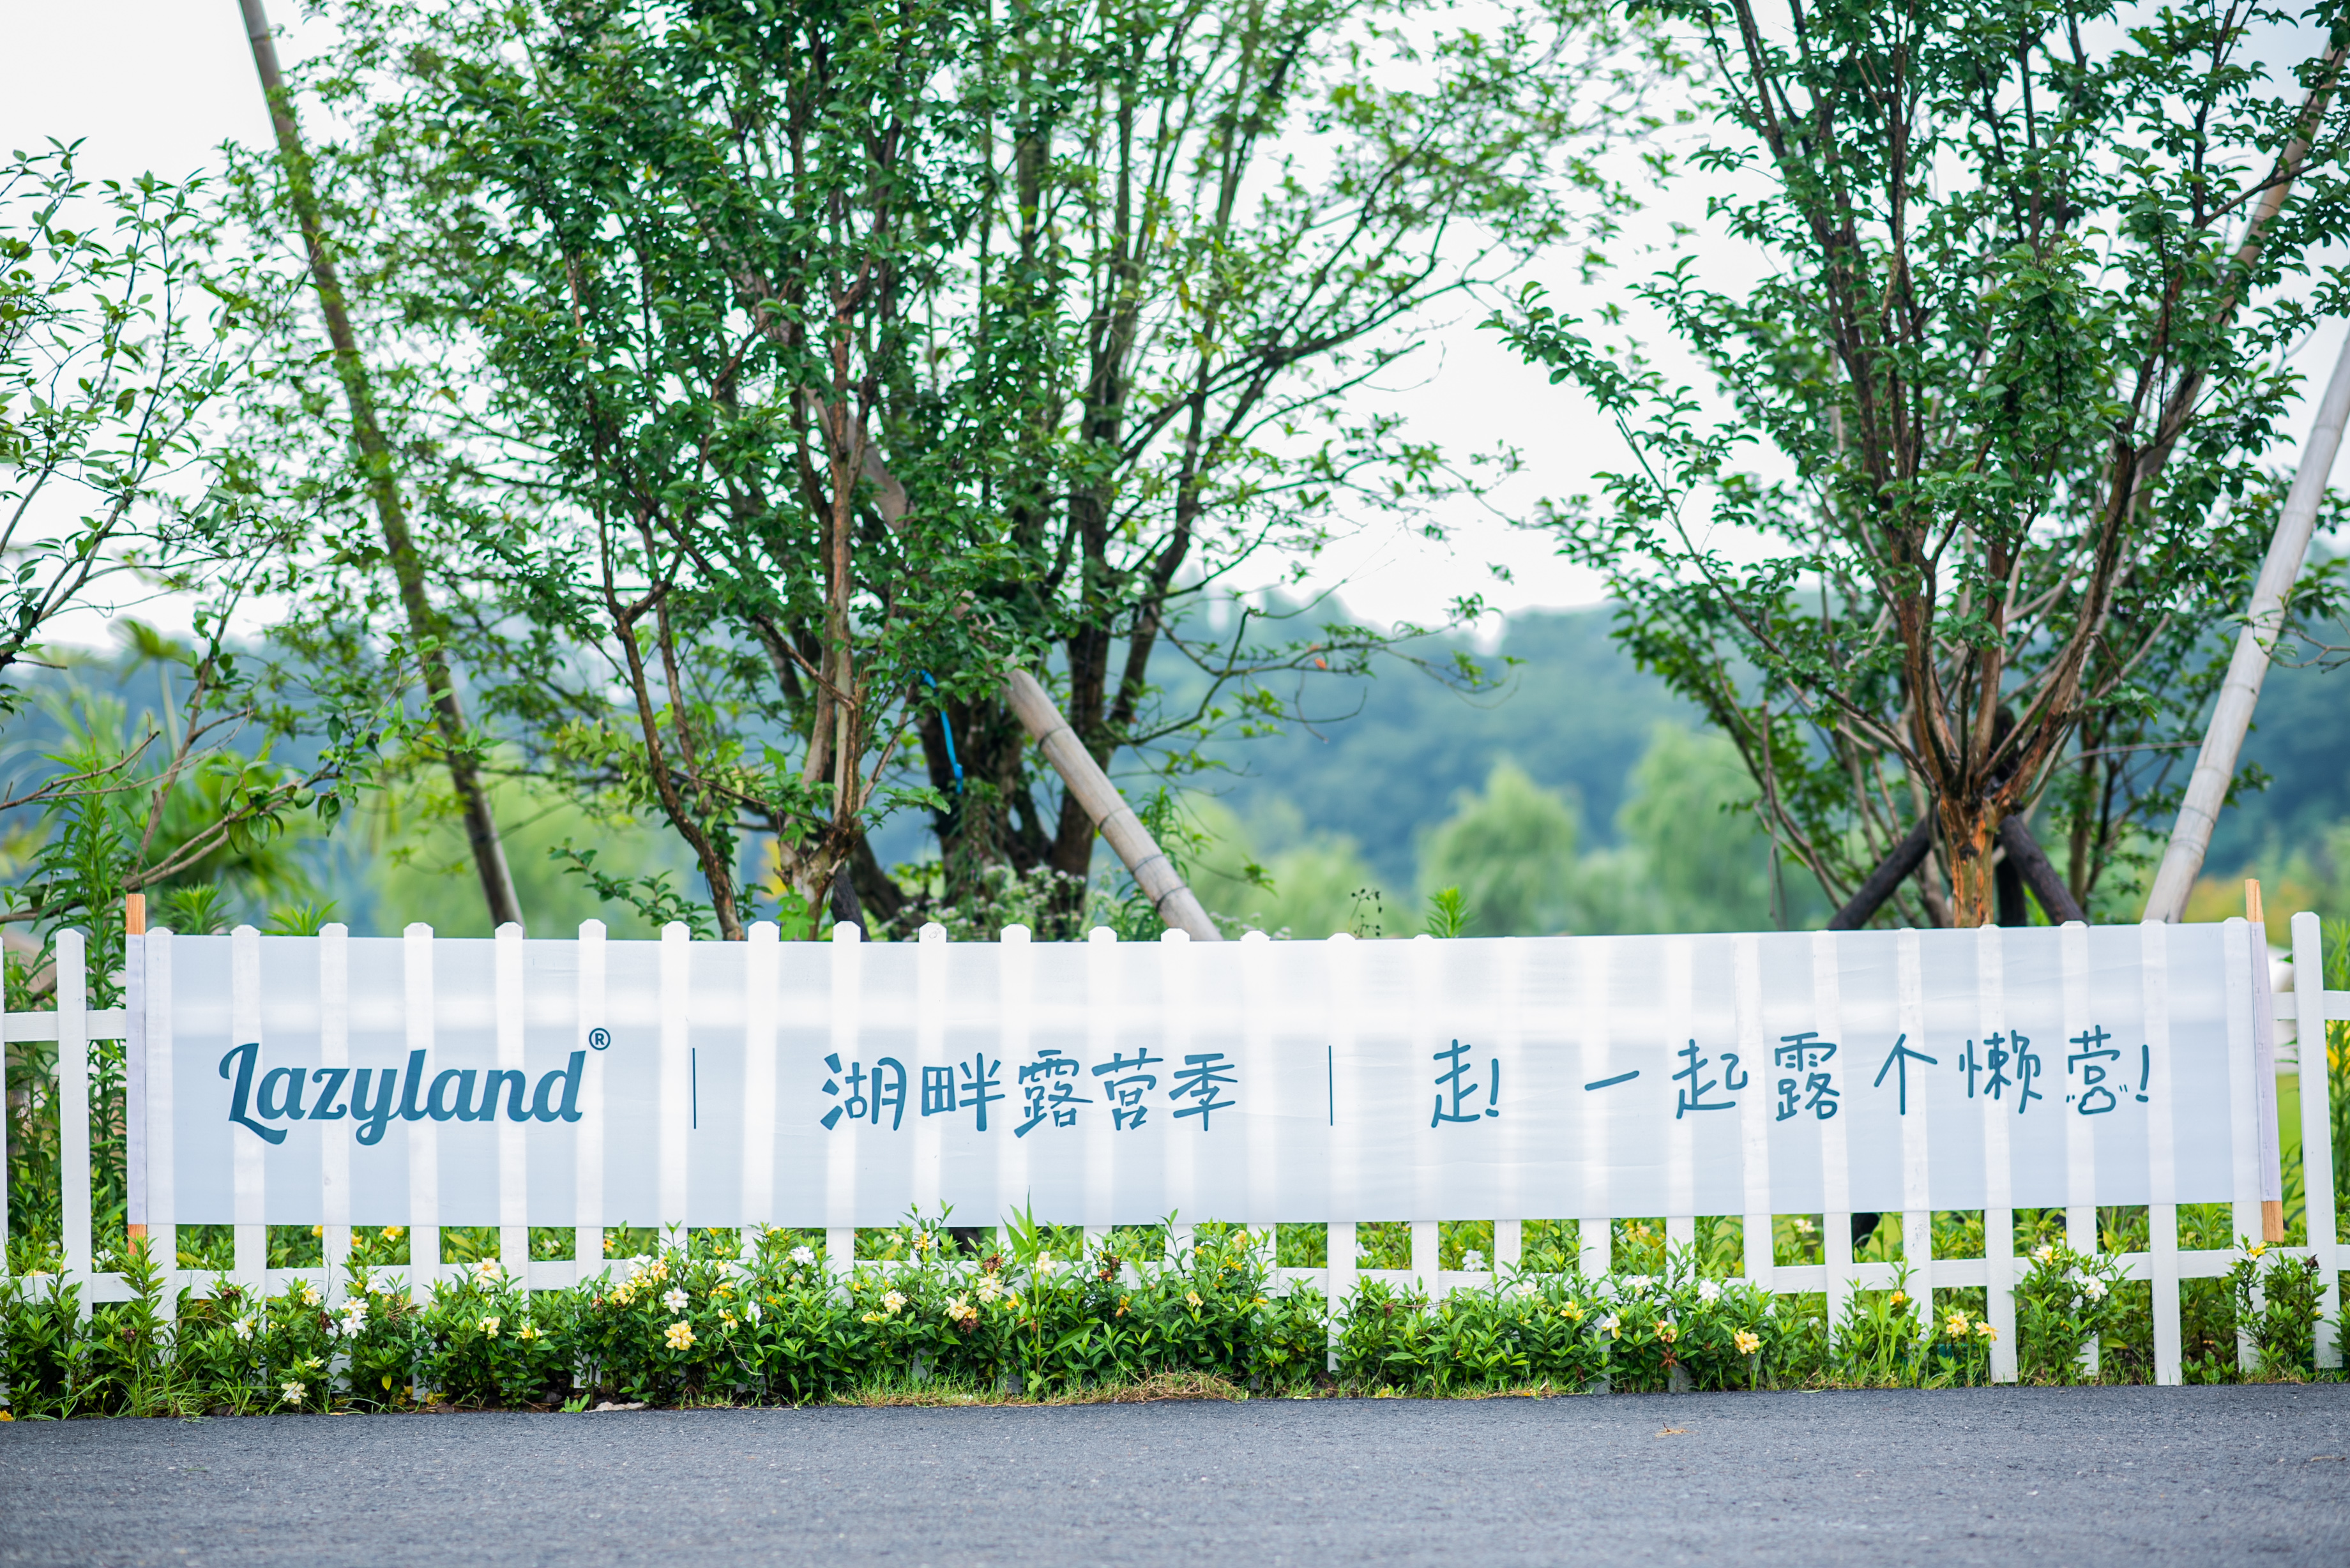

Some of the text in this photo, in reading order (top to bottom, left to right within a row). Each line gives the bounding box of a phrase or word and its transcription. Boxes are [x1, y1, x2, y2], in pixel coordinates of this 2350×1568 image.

[218, 1043, 586, 1146] Lazyland
[820, 1047, 1238, 1138] 湖畔露营季
